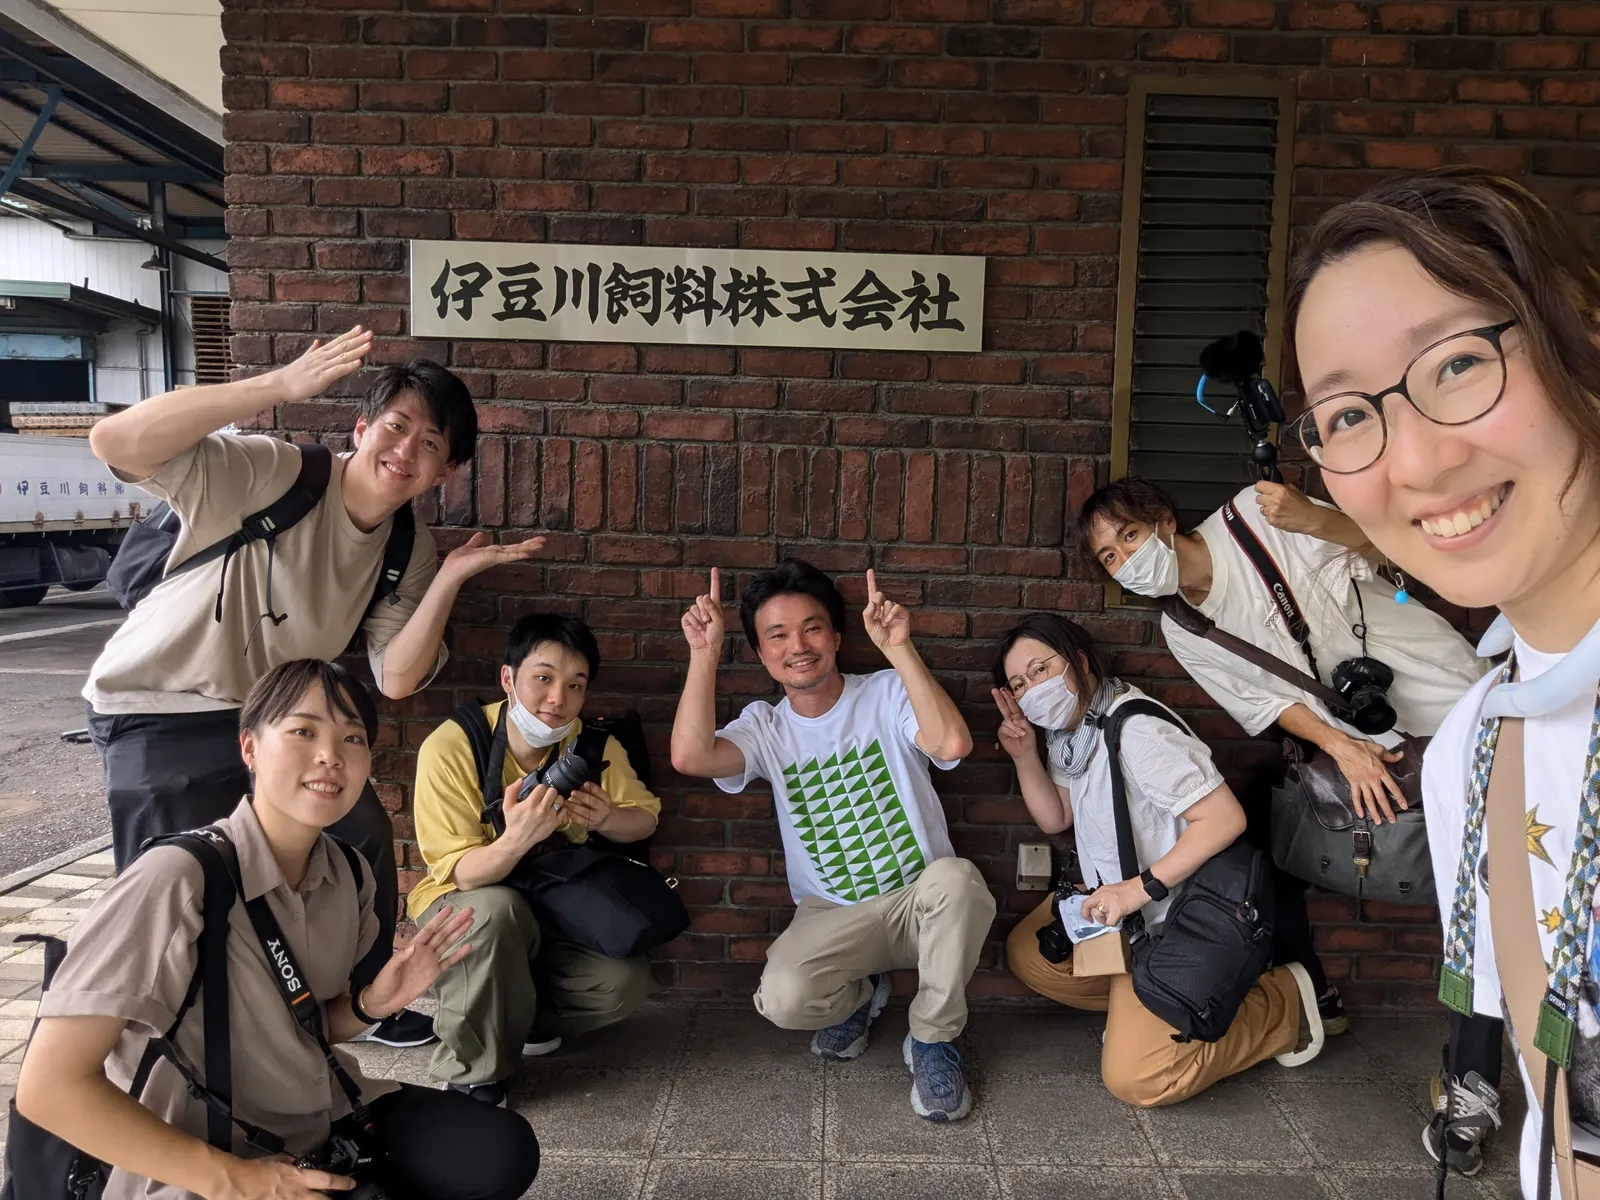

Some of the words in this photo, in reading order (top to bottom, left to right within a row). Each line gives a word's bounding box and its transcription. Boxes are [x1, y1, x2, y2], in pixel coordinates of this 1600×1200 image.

[431, 259, 965, 332] 伊豆川飼料株式会社
[1273, 582, 1294, 618] Canon
[267, 938, 302, 992] SONY
